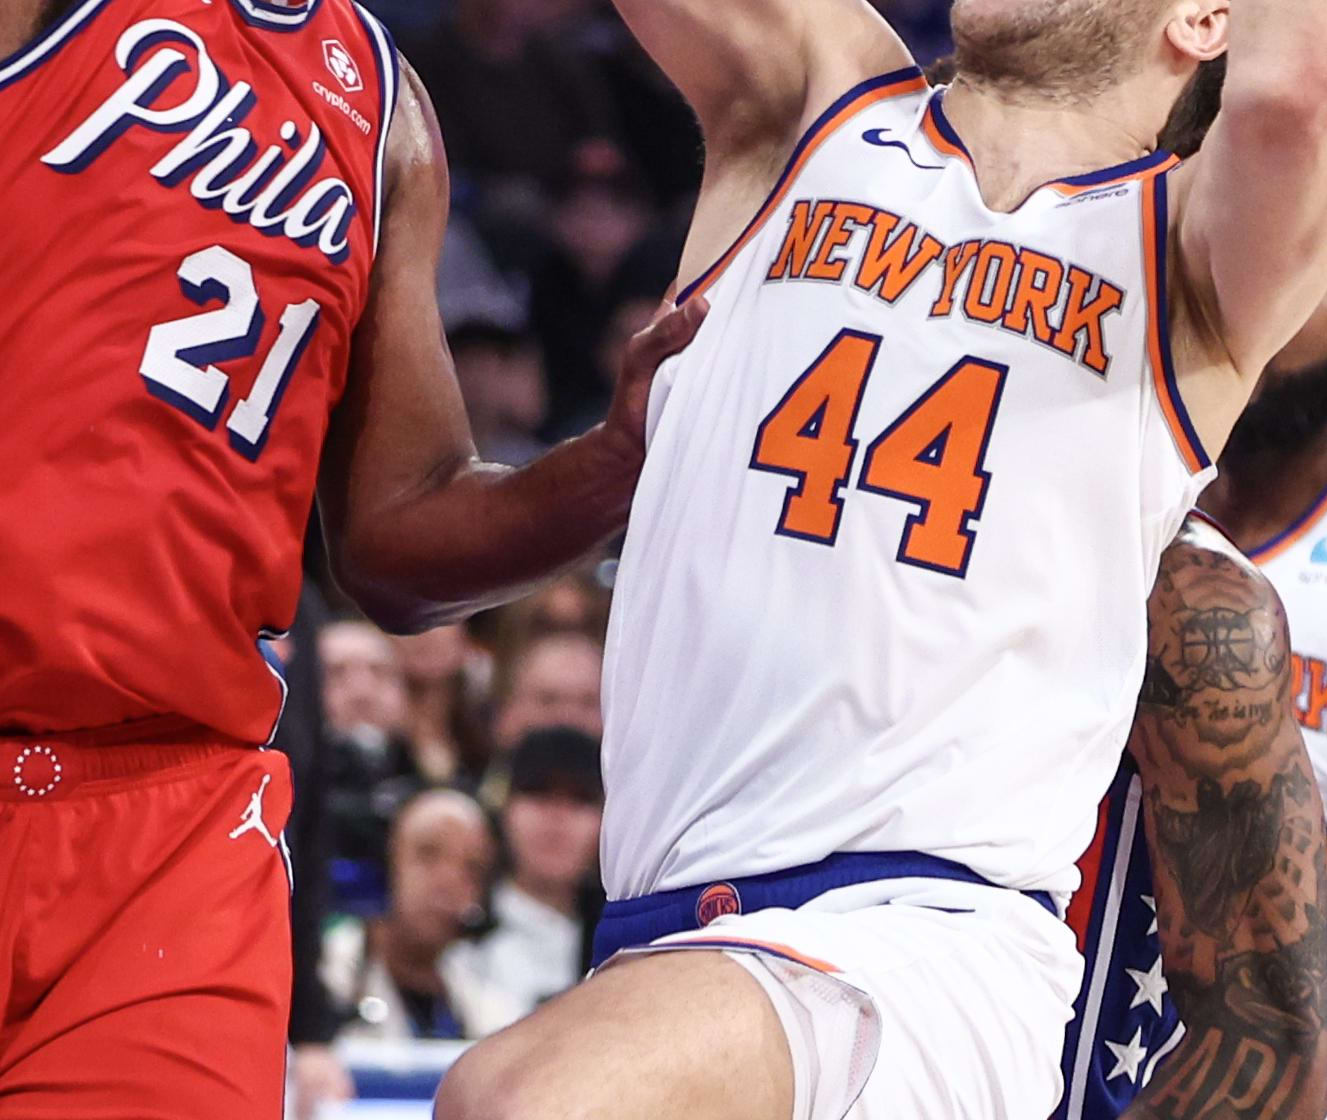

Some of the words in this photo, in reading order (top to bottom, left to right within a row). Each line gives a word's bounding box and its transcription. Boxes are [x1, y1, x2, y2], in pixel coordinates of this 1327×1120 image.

[40, 18, 356, 264] Phila
[312, 81, 371, 135] crypto.com
[139, 245, 321, 461] 21
[765, 200, 944, 307] NEW
[928, 240, 1128, 380] YORK
[748, 327, 1009, 578] 44
